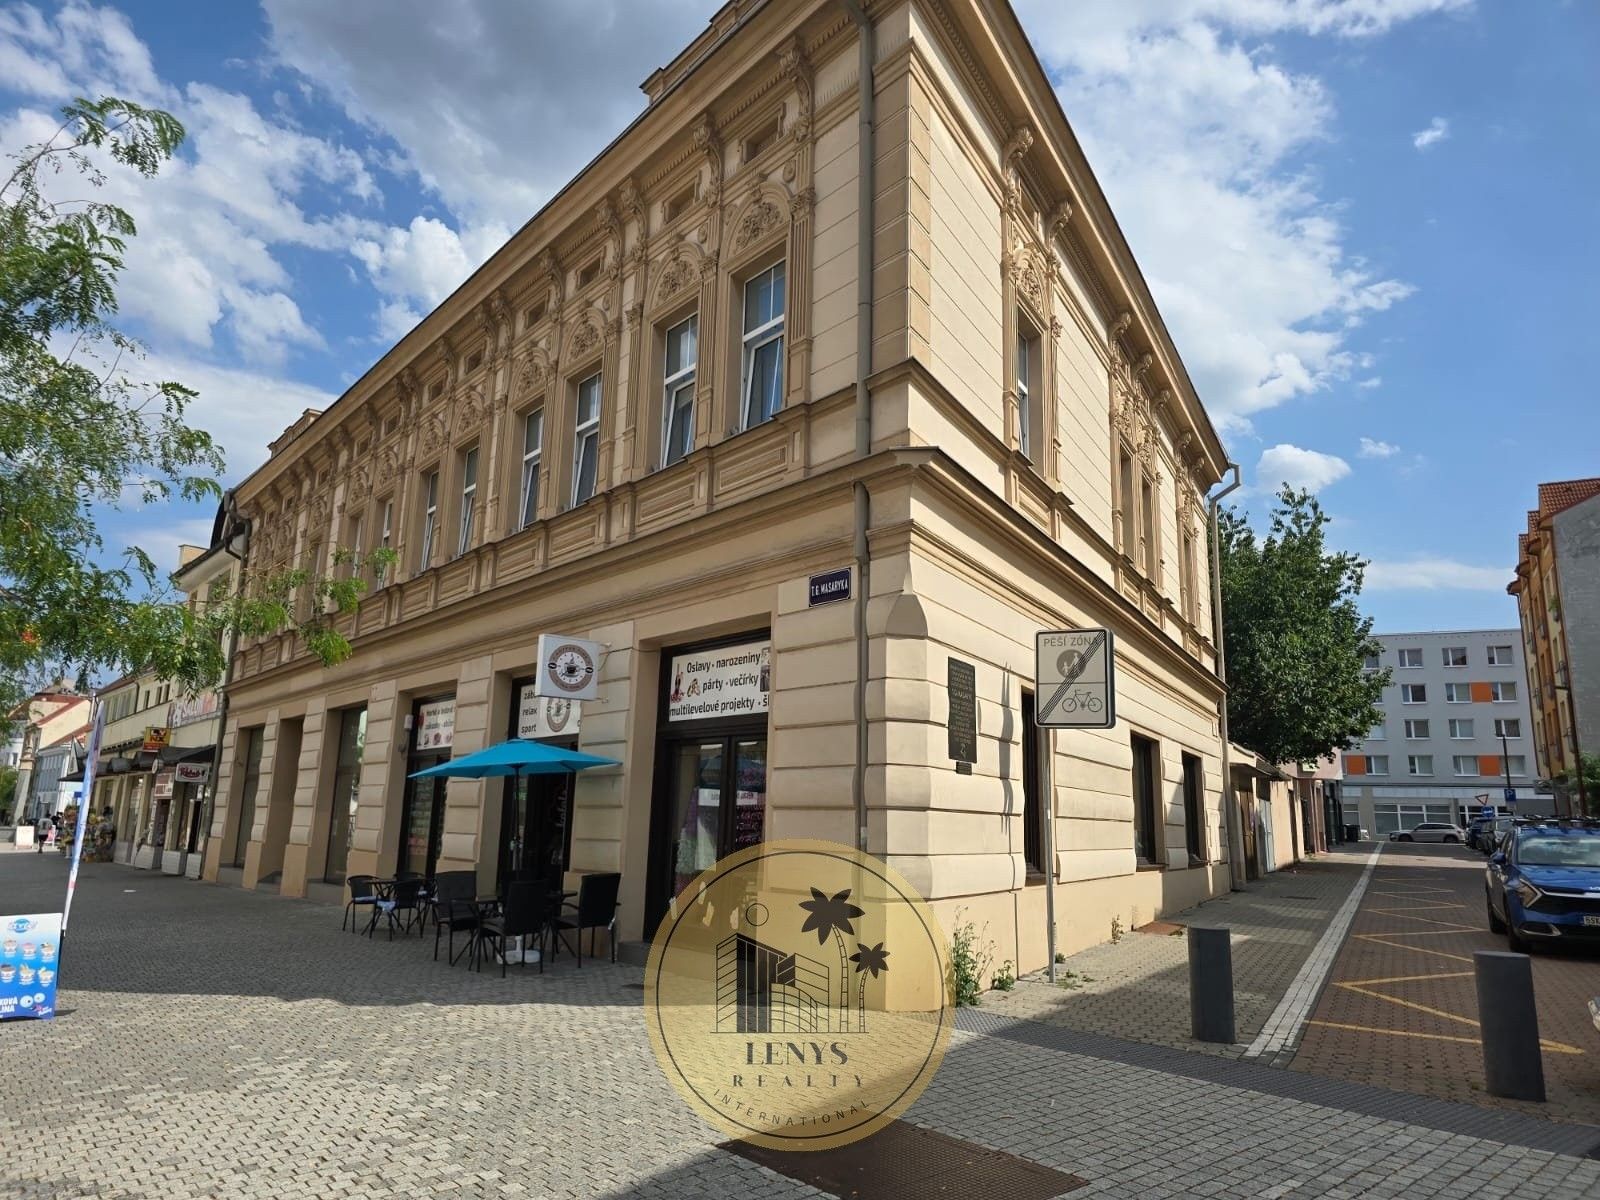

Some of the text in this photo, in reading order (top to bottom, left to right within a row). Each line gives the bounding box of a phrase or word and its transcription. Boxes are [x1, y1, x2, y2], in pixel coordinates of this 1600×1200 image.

[820, 578, 849, 595] MASARYKA
[687, 651, 761, 673] Oslavy narozeniny
[702, 673, 759, 693] párty večírky
[522, 706, 538, 717] relax
[670, 699, 720, 717] multilevelové
[720, 697, 755, 713] projekty
[521, 723, 537, 734] sport
